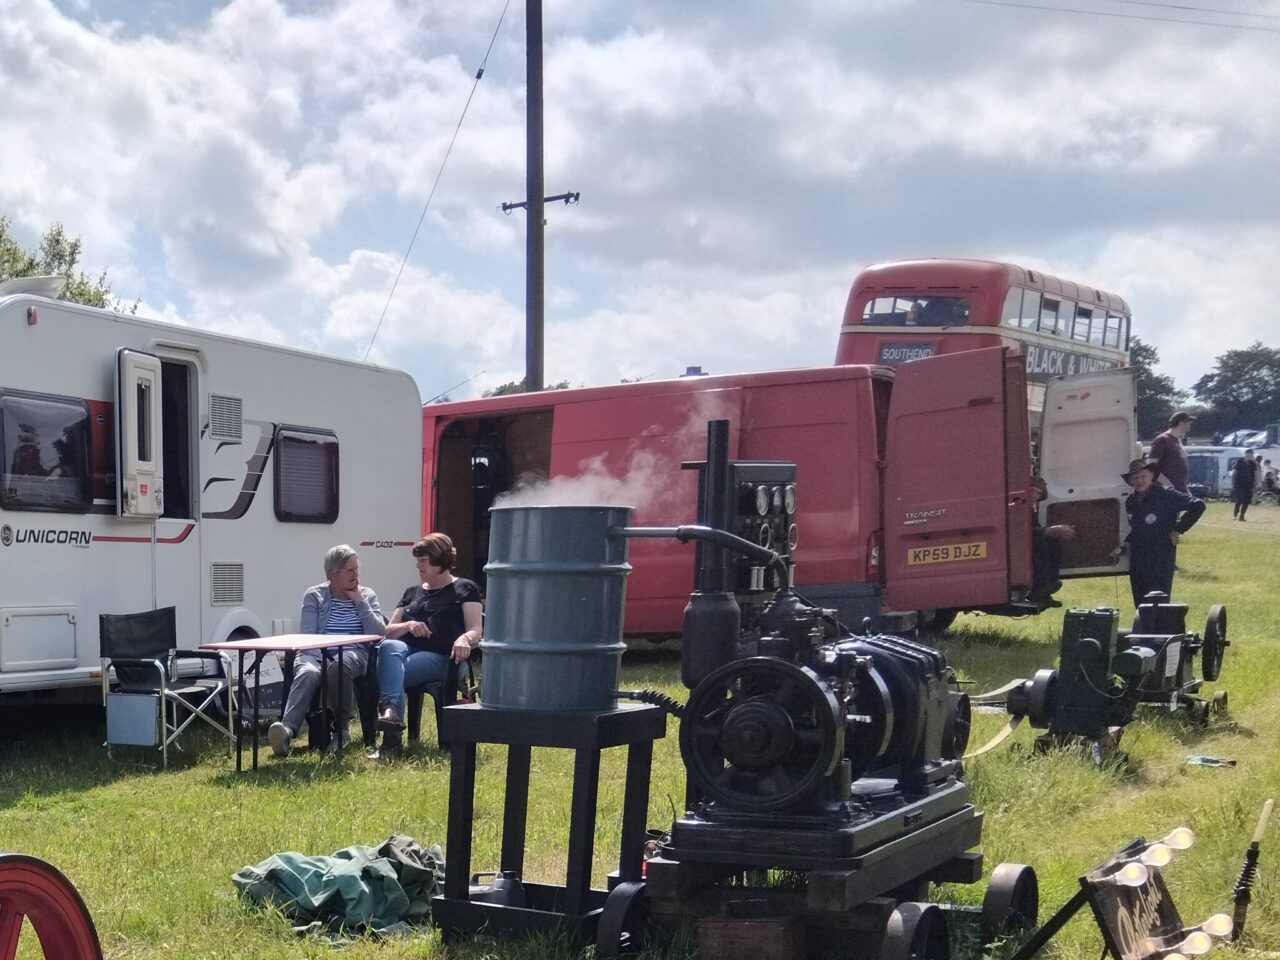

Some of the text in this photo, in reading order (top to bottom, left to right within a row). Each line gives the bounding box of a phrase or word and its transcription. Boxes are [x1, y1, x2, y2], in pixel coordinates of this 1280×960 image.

[882, 348, 932, 360] SOUTHEND
[1026, 346, 1065, 374] BLACK
[1067, 355, 1076, 376] &
[904, 509, 946, 519] TRANSIT
[15, 529, 92, 544] UNICORN
[913, 544, 980, 562] KP59 DJZ
